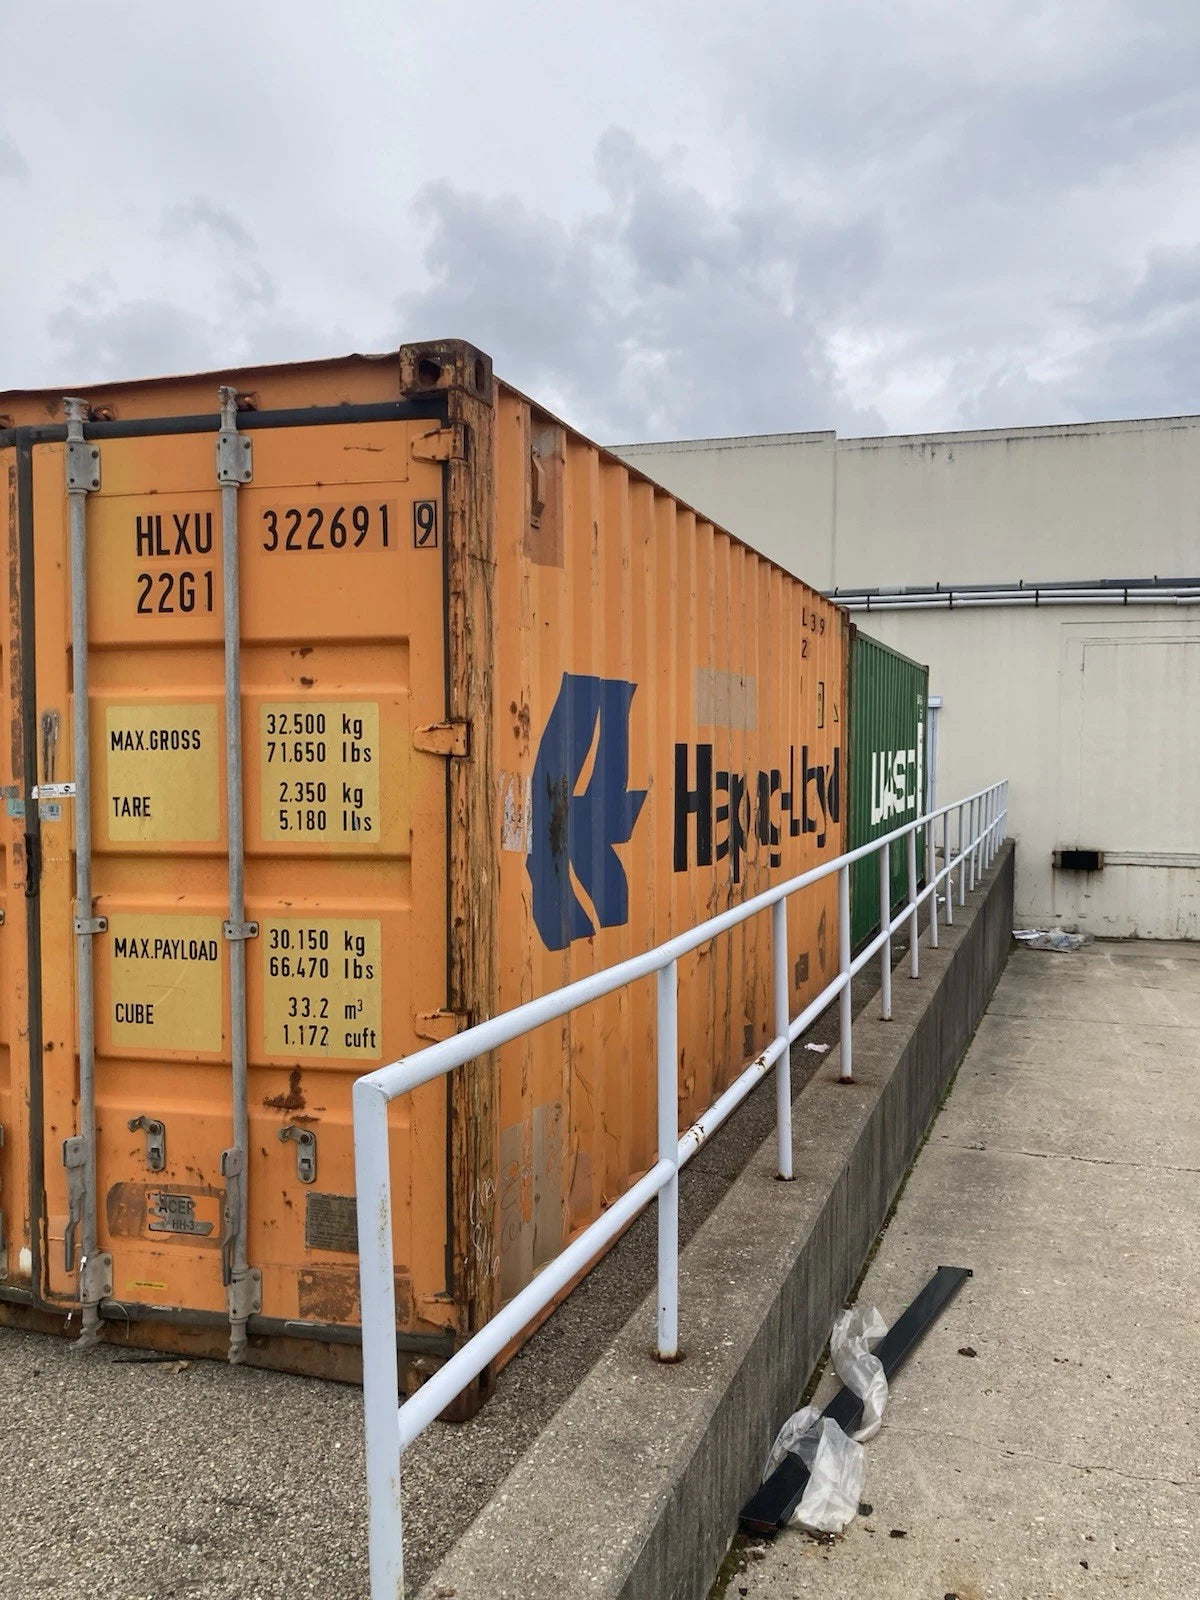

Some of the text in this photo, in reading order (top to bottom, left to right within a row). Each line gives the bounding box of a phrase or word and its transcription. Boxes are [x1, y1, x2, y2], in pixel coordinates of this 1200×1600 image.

[136, 502, 435, 557] HLXU 322691 9
[137, 570, 213, 614] 22G1
[342, 713, 363, 740] kg
[111, 729, 201, 751] MAX.GROSS
[342, 741, 372, 763] lbs
[112, 796, 151, 817] TARE
[342, 782, 363, 809] kg
[342, 810, 372, 832] lbs
[114, 937, 218, 961] MAX.PAYLOAD
[344, 930, 365, 957] kg
[344, 957, 374, 980] lbs
[115, 1003, 154, 1025] CUBE
[288, 996, 329, 1019] 33.2
[344, 1027, 377, 1049] cuft
